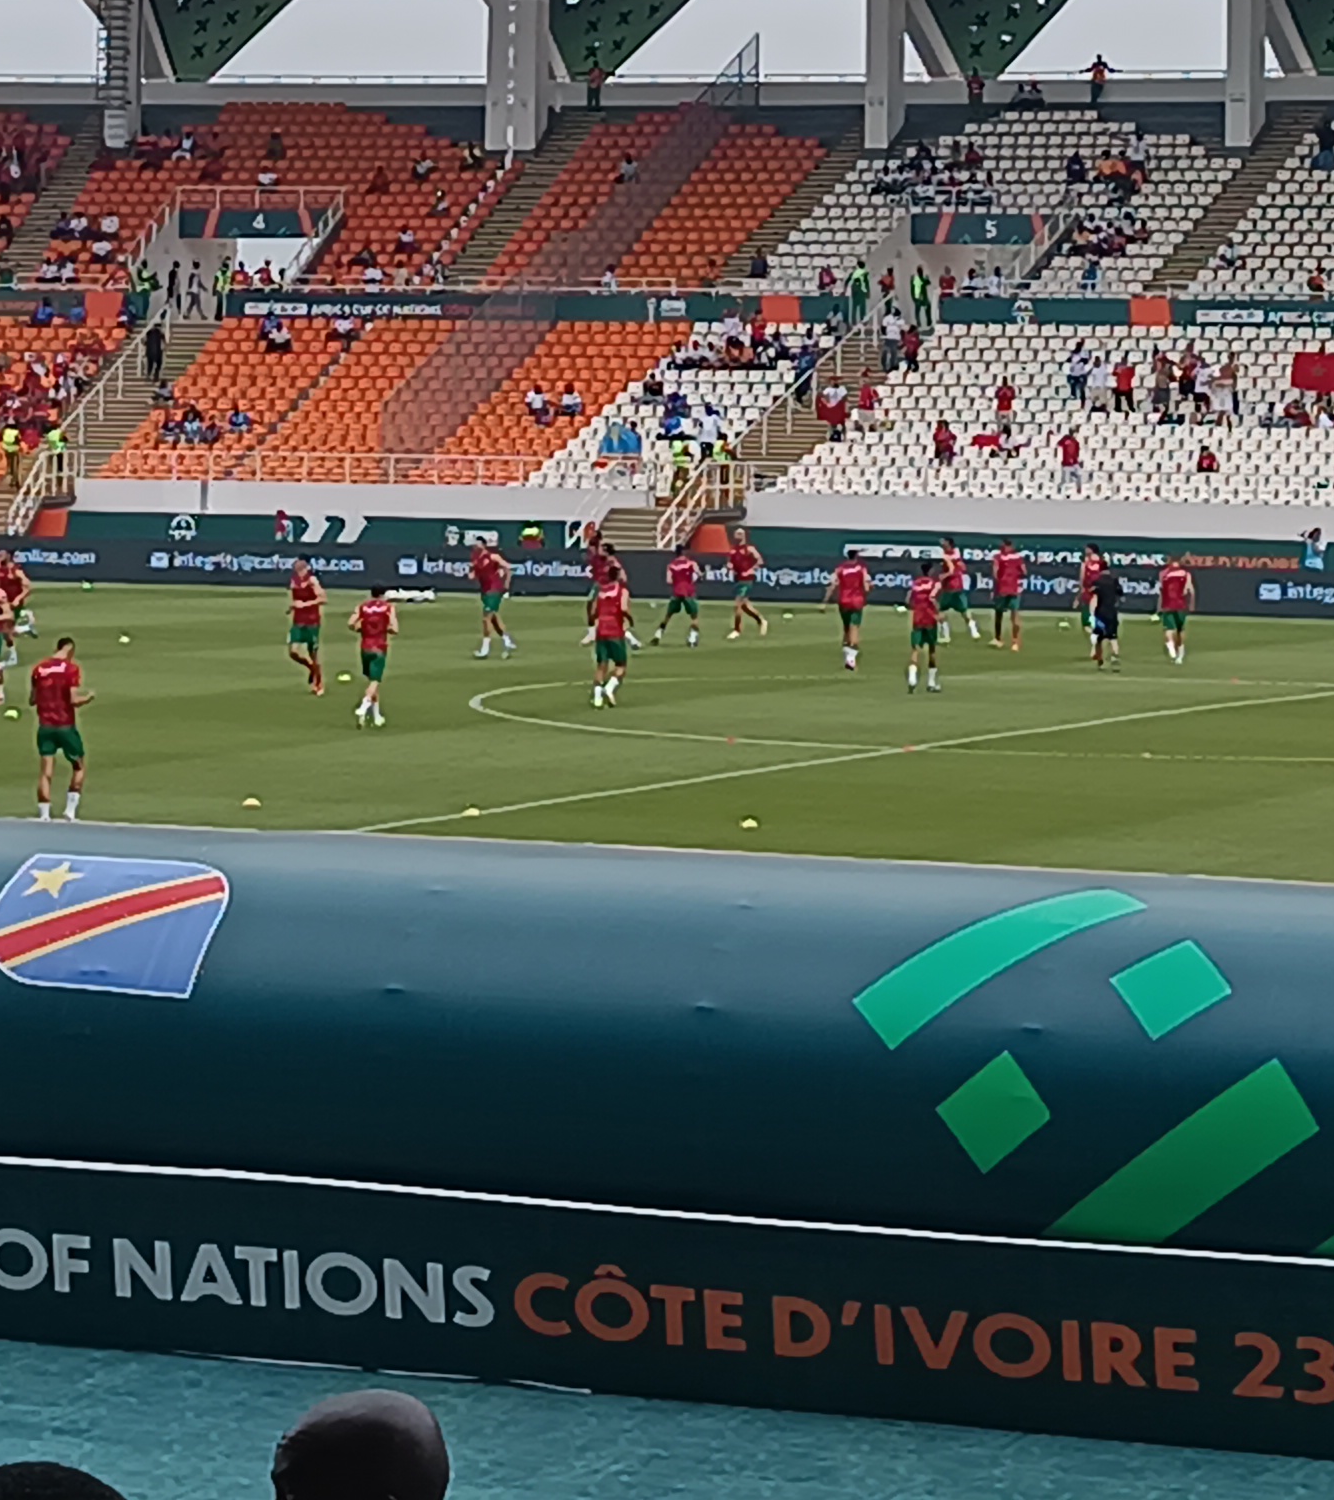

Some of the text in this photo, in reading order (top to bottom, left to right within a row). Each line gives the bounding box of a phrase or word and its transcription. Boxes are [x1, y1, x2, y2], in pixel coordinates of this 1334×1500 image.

[112, 1237, 496, 1328] NATIONS
[513, 1263, 747, 1352] CÔTE
[771, 1294, 1201, 1393] D'IVOIRE
